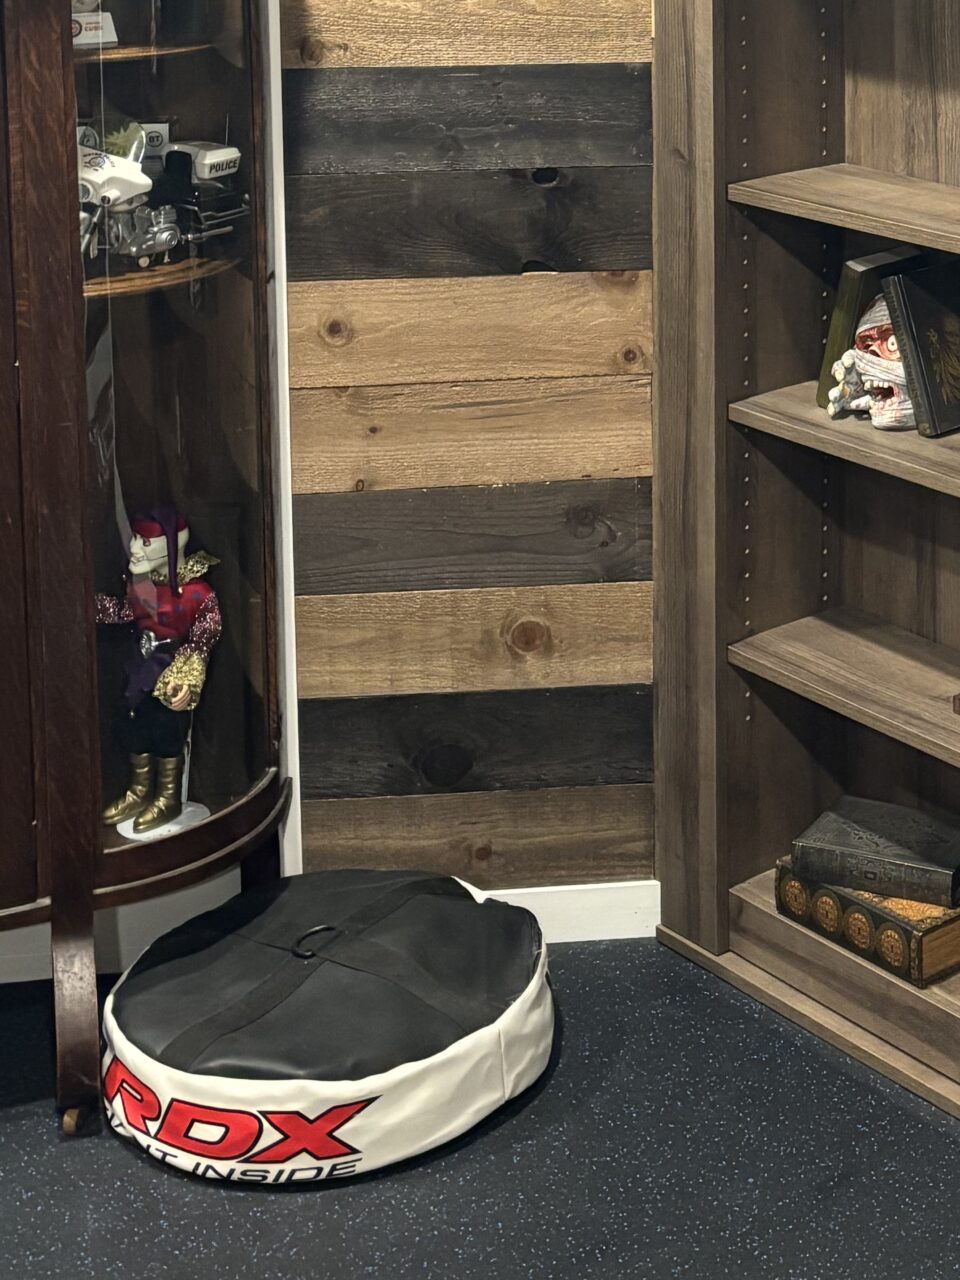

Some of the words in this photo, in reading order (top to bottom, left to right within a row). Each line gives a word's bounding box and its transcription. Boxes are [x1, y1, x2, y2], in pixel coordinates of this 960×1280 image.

[209, 160, 238, 174] POLICE
[104, 1054, 384, 1164] RDX
[190, 1157, 363, 1185] INSIDE
